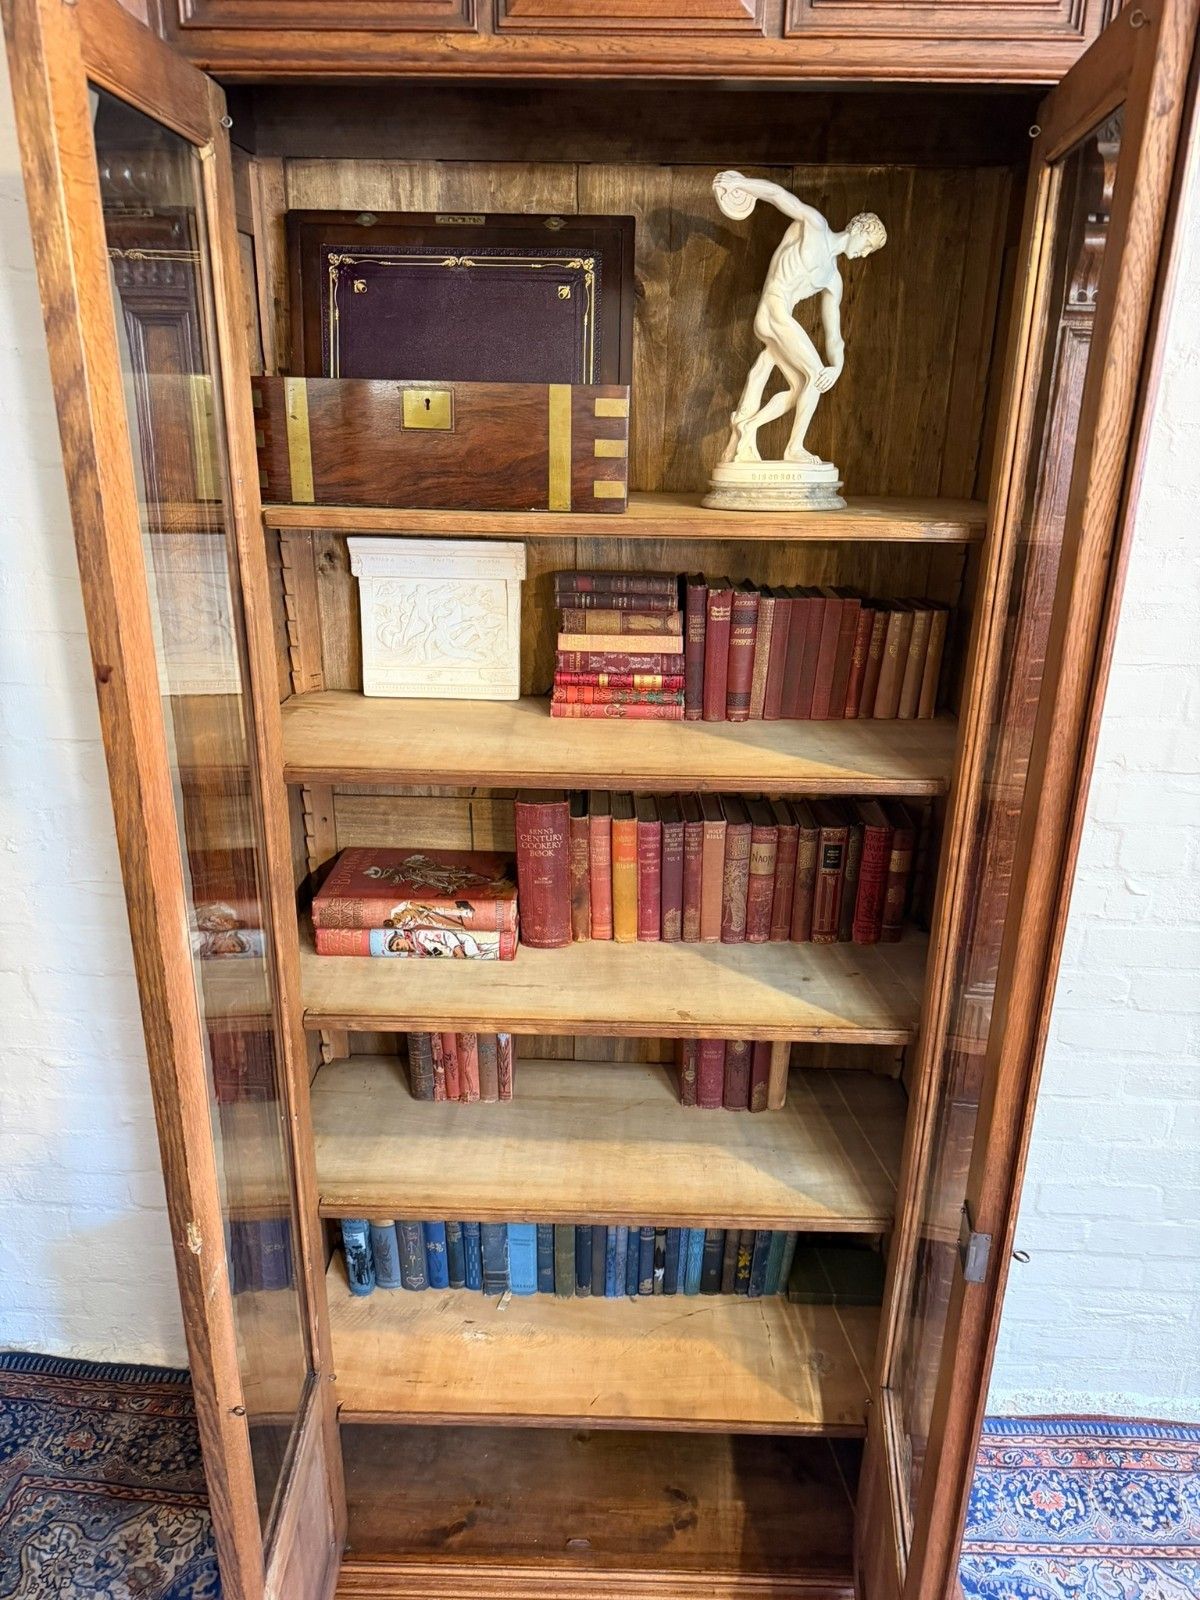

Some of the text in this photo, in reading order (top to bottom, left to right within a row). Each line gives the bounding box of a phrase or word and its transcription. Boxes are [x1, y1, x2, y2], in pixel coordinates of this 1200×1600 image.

[733, 627, 752, 635] DAVID
[520, 833, 563, 842] CENTURY
[521, 840, 563, 849] COOKERY
[529, 849, 555, 857] BOOK
